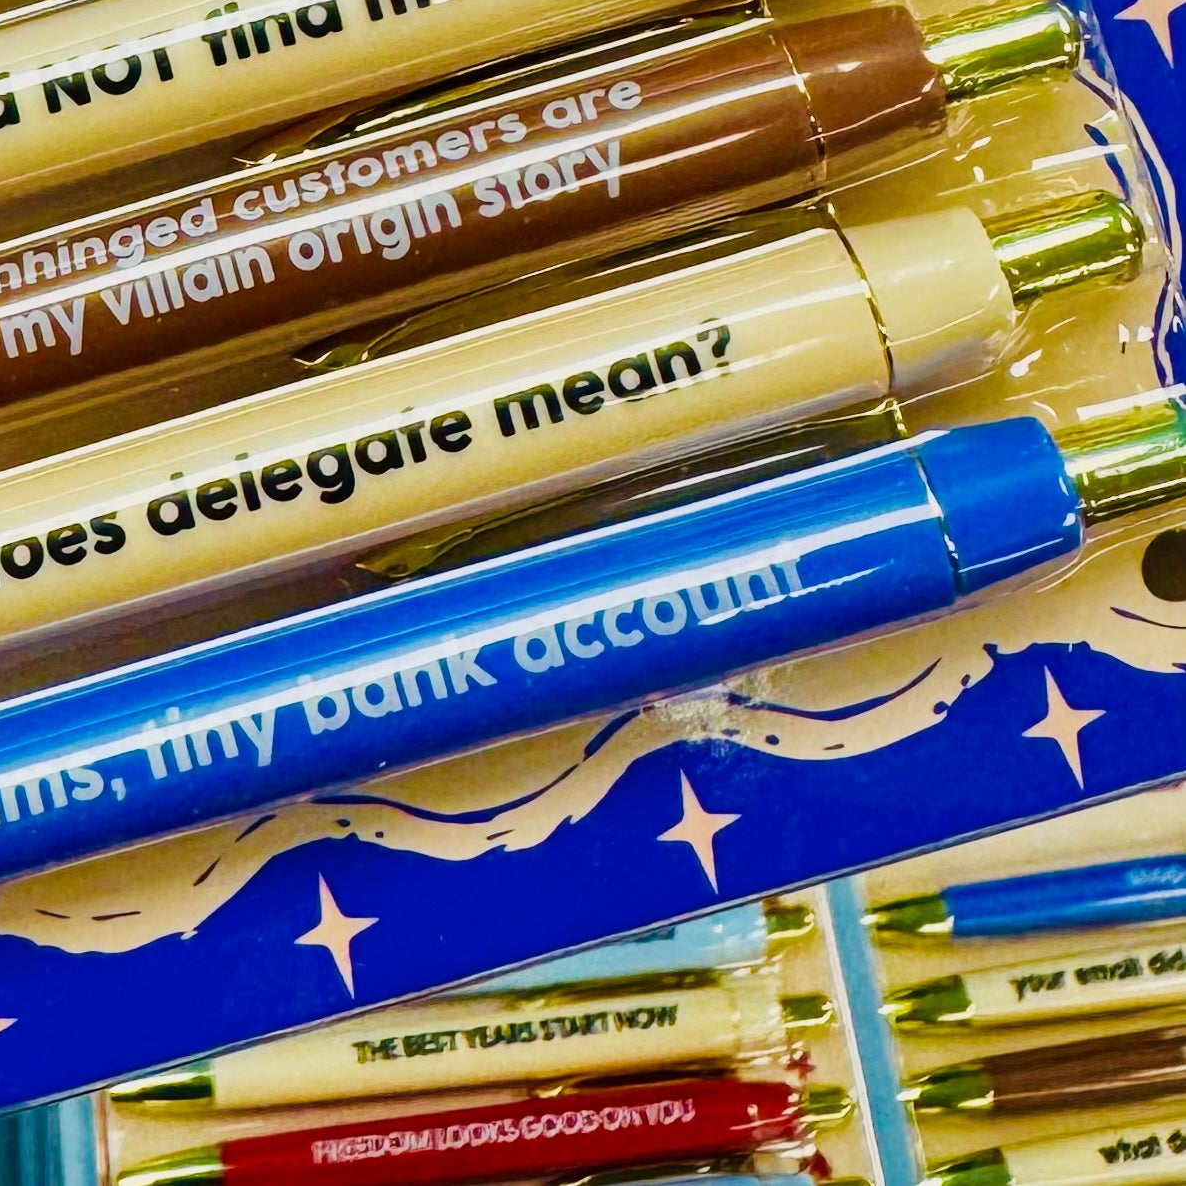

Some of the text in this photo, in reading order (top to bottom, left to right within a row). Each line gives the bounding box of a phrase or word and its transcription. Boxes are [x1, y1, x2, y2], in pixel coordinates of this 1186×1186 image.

[40, 28, 174, 114] NOT
[233, 106, 527, 222] customers
[542, 75, 644, 130] are
[101, 244, 276, 326] villain
[292, 191, 462, 271] origin
[478, 140, 621, 218] story
[147, 406, 472, 535] delegate
[494, 317, 732, 438] mean?
[145, 694, 275, 782] tiny
[303, 634, 498, 737] bank
[513, 553, 807, 675] account
[351, 1035, 400, 1064] THE
[612, 1003, 680, 1031] NOW
[520, 1108, 601, 1140] GOOD
[645, 1098, 696, 1126] YOU
